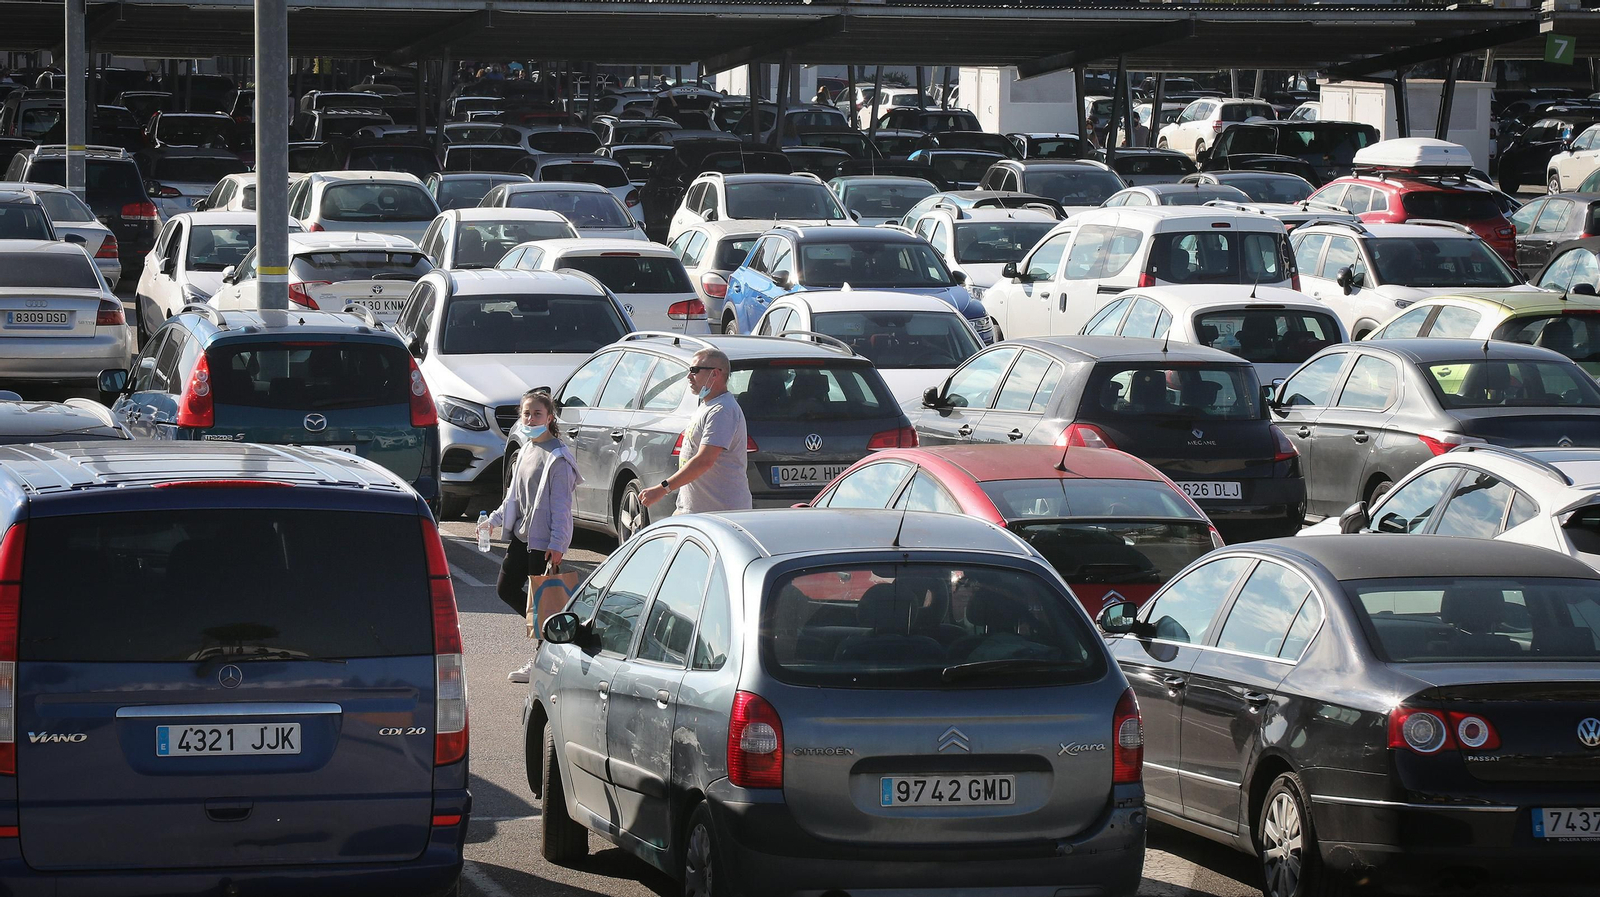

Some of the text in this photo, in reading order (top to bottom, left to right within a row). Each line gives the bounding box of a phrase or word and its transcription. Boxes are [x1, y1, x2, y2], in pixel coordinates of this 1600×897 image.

[1555, 39, 1568, 59] 7
[16, 312, 43, 323] 8309
[46, 313, 67, 323] DSD
[781, 467, 818, 481] 0242
[1176, 483, 1239, 496] 626 DLJ
[28, 731, 87, 743] VIANO
[405, 726, 427, 736] 20
[178, 727, 295, 752] 4321 JJK
[1057, 741, 1106, 756] Xsara
[896, 778, 1011, 802] 9742 GMD
[1550, 812, 1600, 832] 7437
